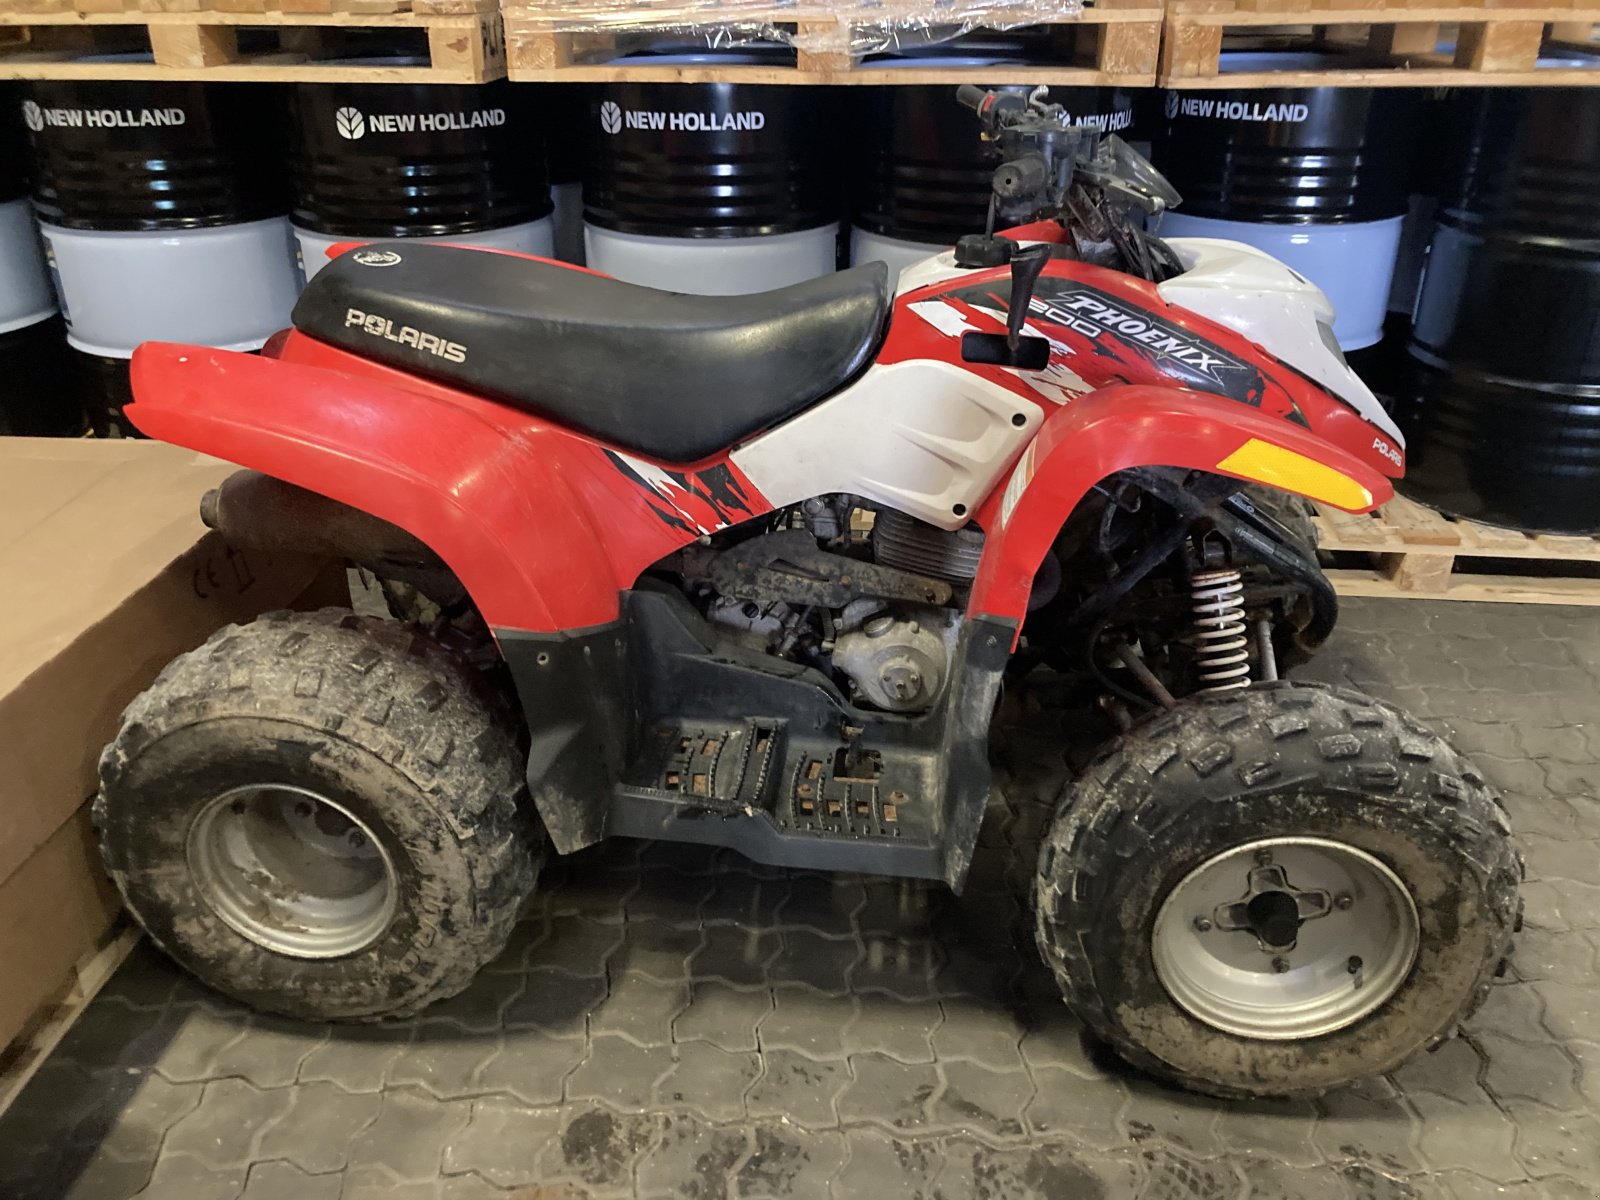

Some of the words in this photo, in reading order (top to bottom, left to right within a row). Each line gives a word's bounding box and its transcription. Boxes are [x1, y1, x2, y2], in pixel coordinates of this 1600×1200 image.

[44, 108, 82, 127] NEW
[85, 108, 185, 127] HOLLAND
[369, 114, 415, 132] NEW
[419, 109, 505, 131] HOLLAND
[625, 111, 666, 130] NEW
[669, 111, 765, 131] HOLLAND
[1181, 98, 1214, 117] NEW
[1216, 101, 1308, 122] HOLLAND
[344, 308, 467, 363] POLARIS
[1064, 294, 1226, 374] PHOENIX
[1372, 437, 1402, 468] POLARIS
